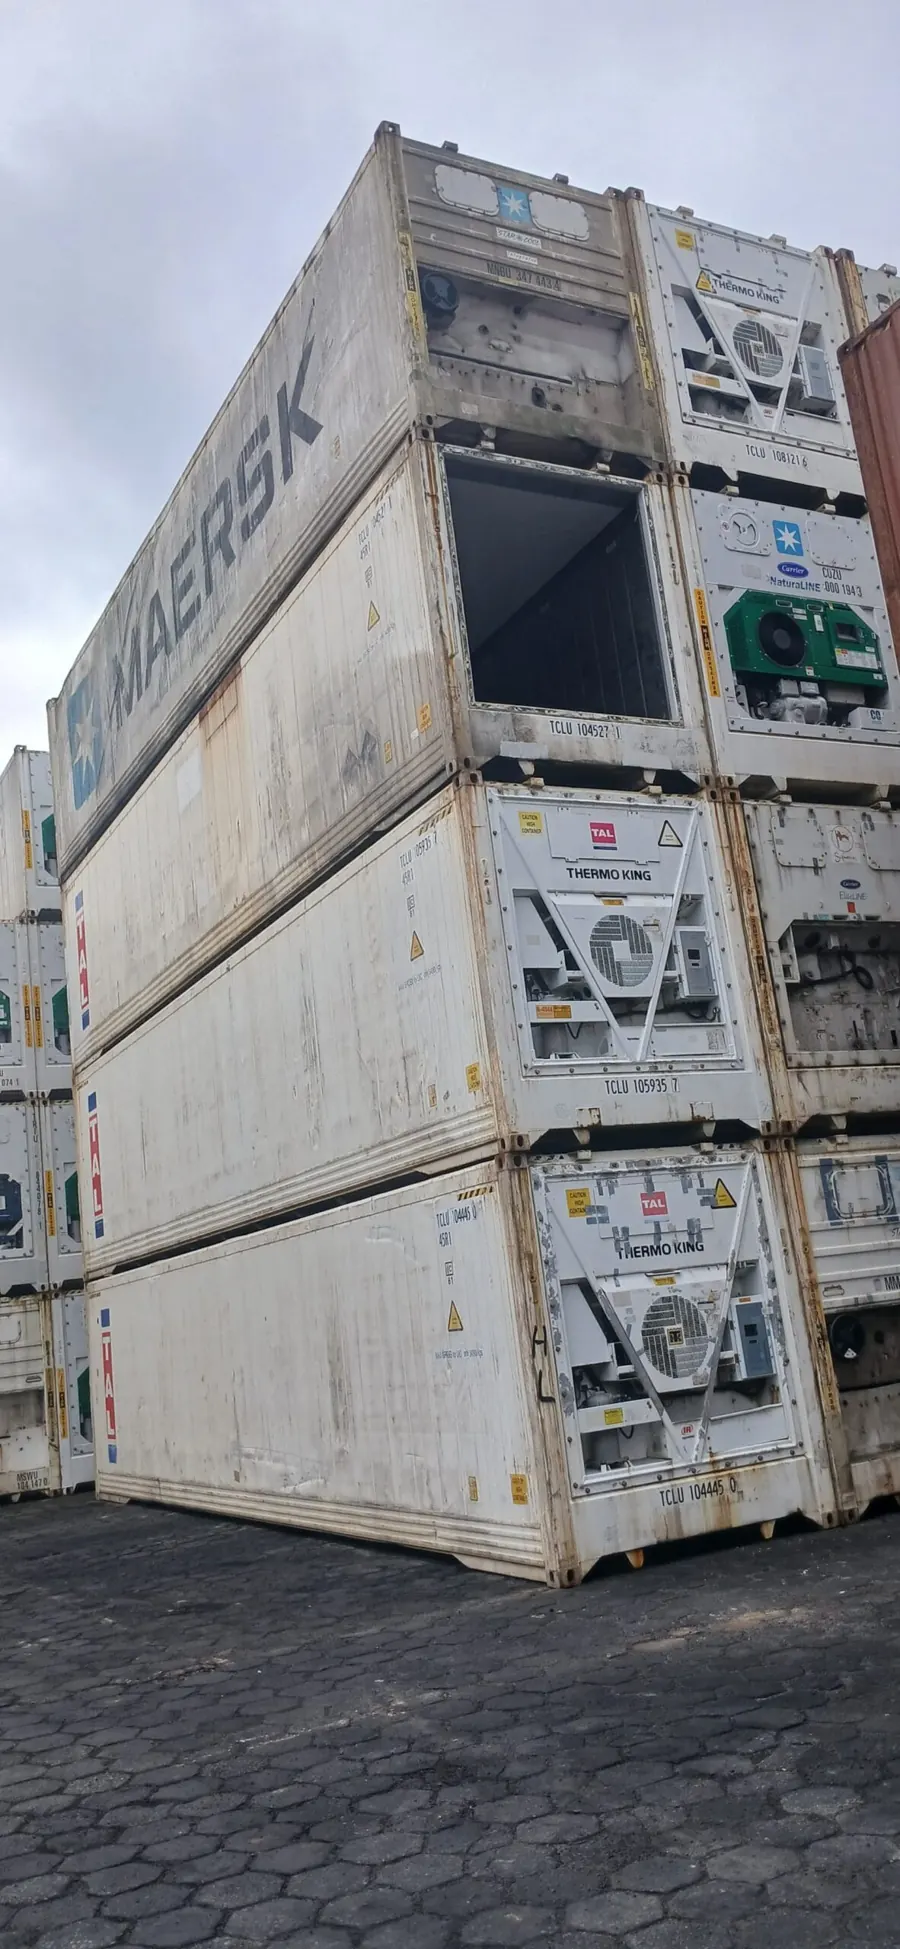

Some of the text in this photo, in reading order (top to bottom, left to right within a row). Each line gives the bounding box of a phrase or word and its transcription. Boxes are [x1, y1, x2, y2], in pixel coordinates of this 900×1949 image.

[486, 262, 511, 279] MNBU
[712, 278, 780, 304] THERMO KING
[745, 444, 809, 468] TCLU 108121 6
[108, 334, 324, 728] MAERSK
[781, 564, 805, 575] Carrier
[822, 567, 842, 580] CUZU
[769, 576, 821, 593] NaturaLINE
[824, 581, 841, 594] 000
[549, 720, 573, 735] TCLU
[577, 723, 609, 739] 104527
[591, 828, 614, 838] TAL
[566, 867, 652, 881] THERMO KING
[77, 914, 89, 1006] TAL
[605, 1077, 679, 1095] TCLU 105935 7
[89, 1117, 102, 1213] TAL
[569, 1191, 587, 1199] CAUTION
[642, 1200, 666, 1209] TAL
[436, 1208, 450, 1229] TCLU
[439, 1231, 452, 1248] 45R1
[618, 1240, 705, 1260] THERMO KING
[102, 1336, 116, 1436] TAL
[659, 1477, 737, 1507] TCLU 104445 0
